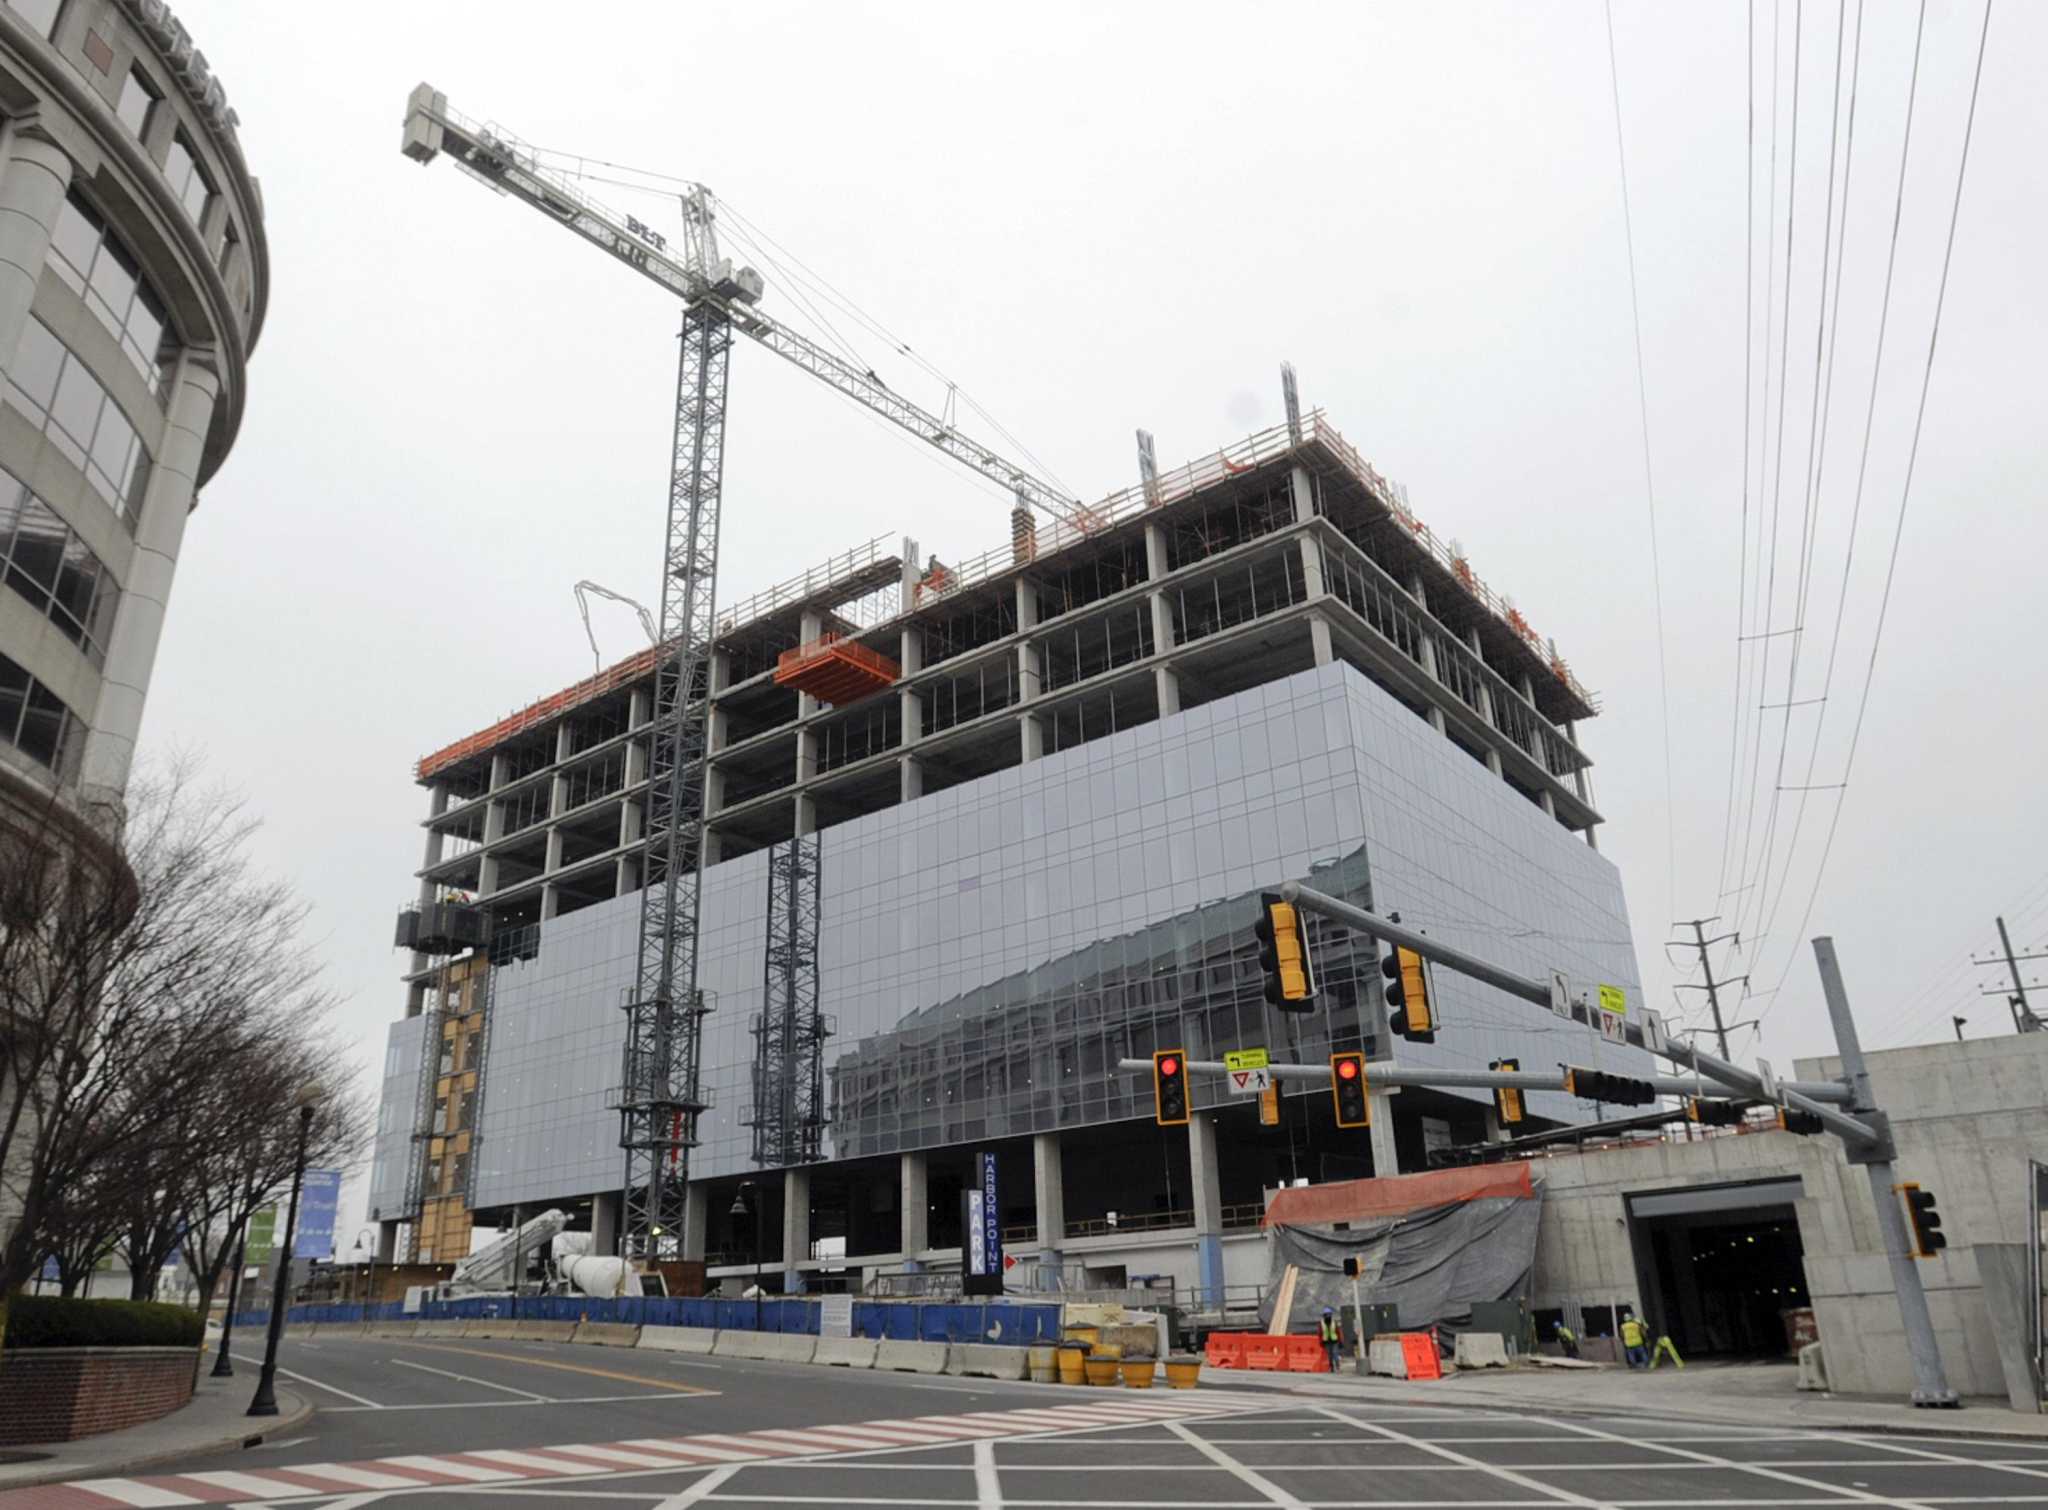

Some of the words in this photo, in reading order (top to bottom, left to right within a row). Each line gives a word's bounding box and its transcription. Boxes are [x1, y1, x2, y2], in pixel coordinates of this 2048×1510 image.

[625, 214, 666, 252] BLT
[985, 1154, 997, 1215] HARBOR
[970, 1194, 983, 1272] PARK
[987, 1219, 998, 1273] POINT
